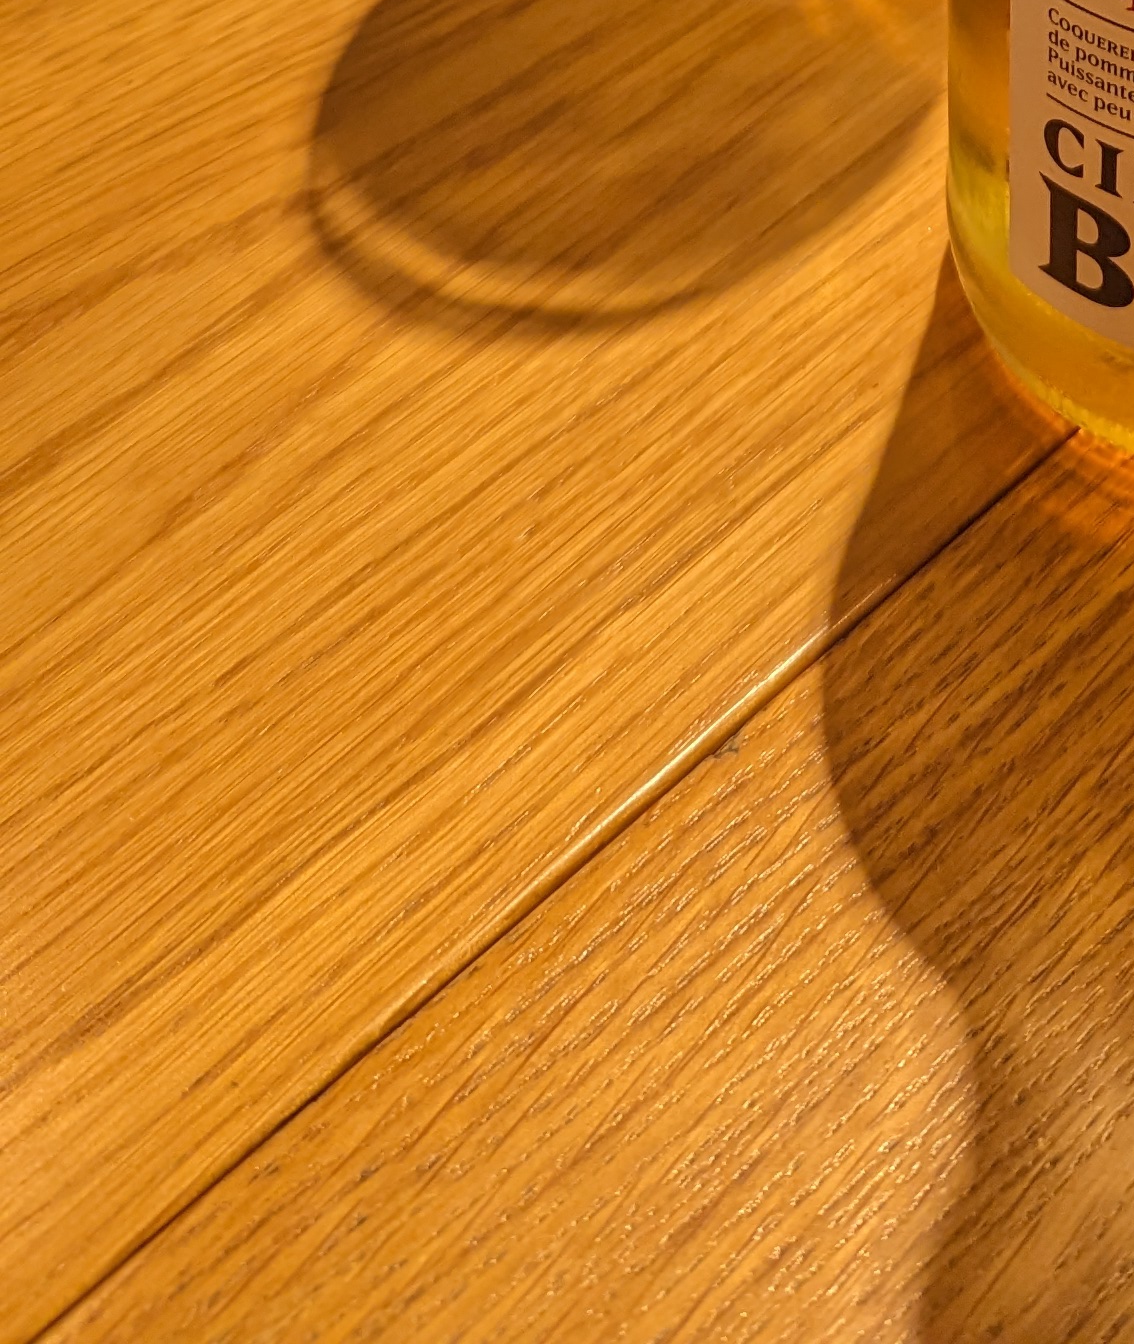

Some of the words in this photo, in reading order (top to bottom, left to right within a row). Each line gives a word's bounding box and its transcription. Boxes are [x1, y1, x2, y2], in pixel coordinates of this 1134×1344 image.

[1048, 29, 1070, 52] de
[1047, 69, 1088, 102] avec
[1094, 95, 1131, 121] peu
